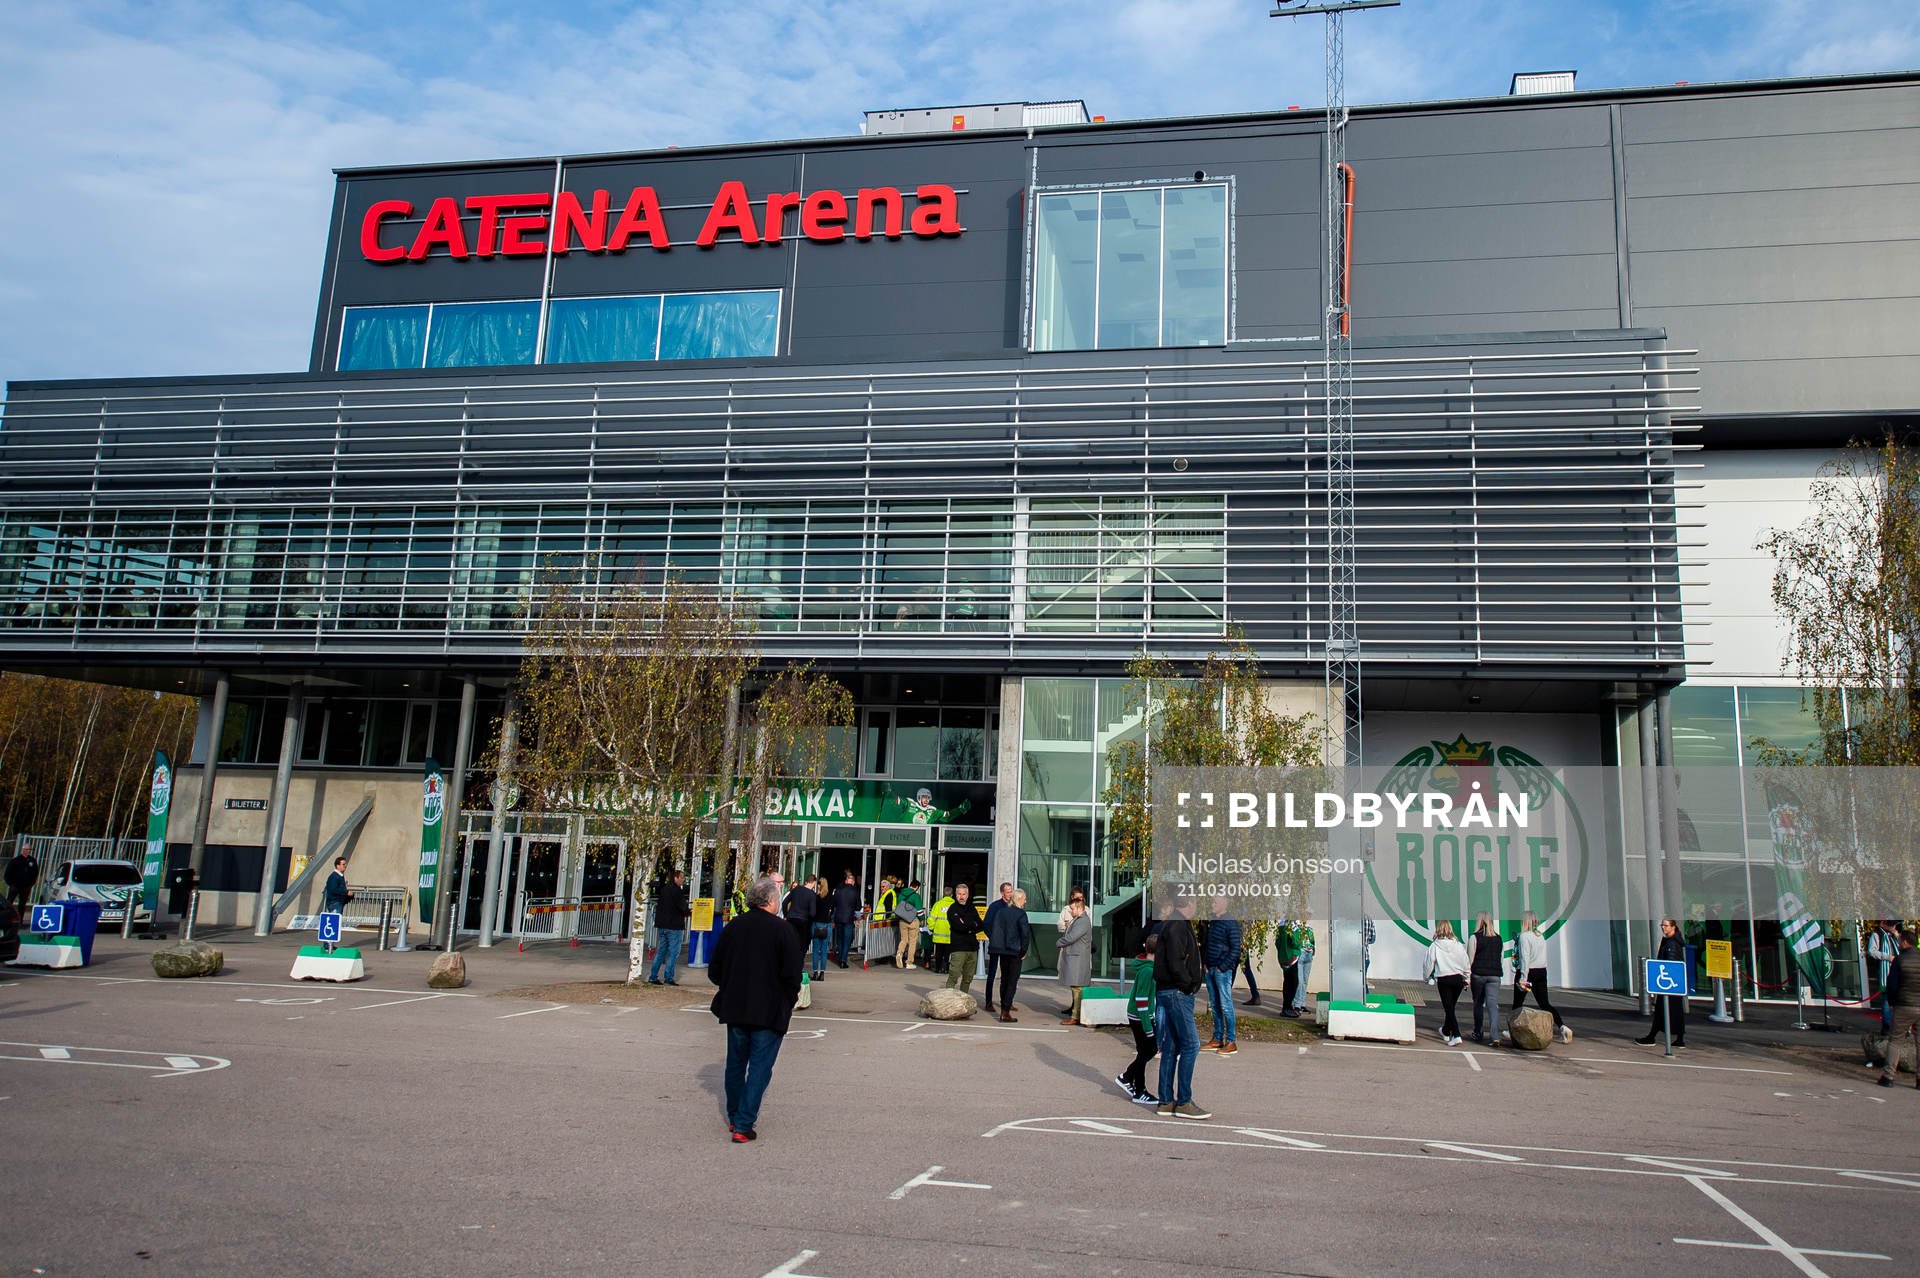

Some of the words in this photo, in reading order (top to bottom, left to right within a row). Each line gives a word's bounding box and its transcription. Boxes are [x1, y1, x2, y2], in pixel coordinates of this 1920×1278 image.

[360, 185, 669, 262] CATENA
[694, 180, 962, 248] Arena
[231, 800, 261, 809] BILJETTER
[1396, 825, 1561, 941] RÖGLE
